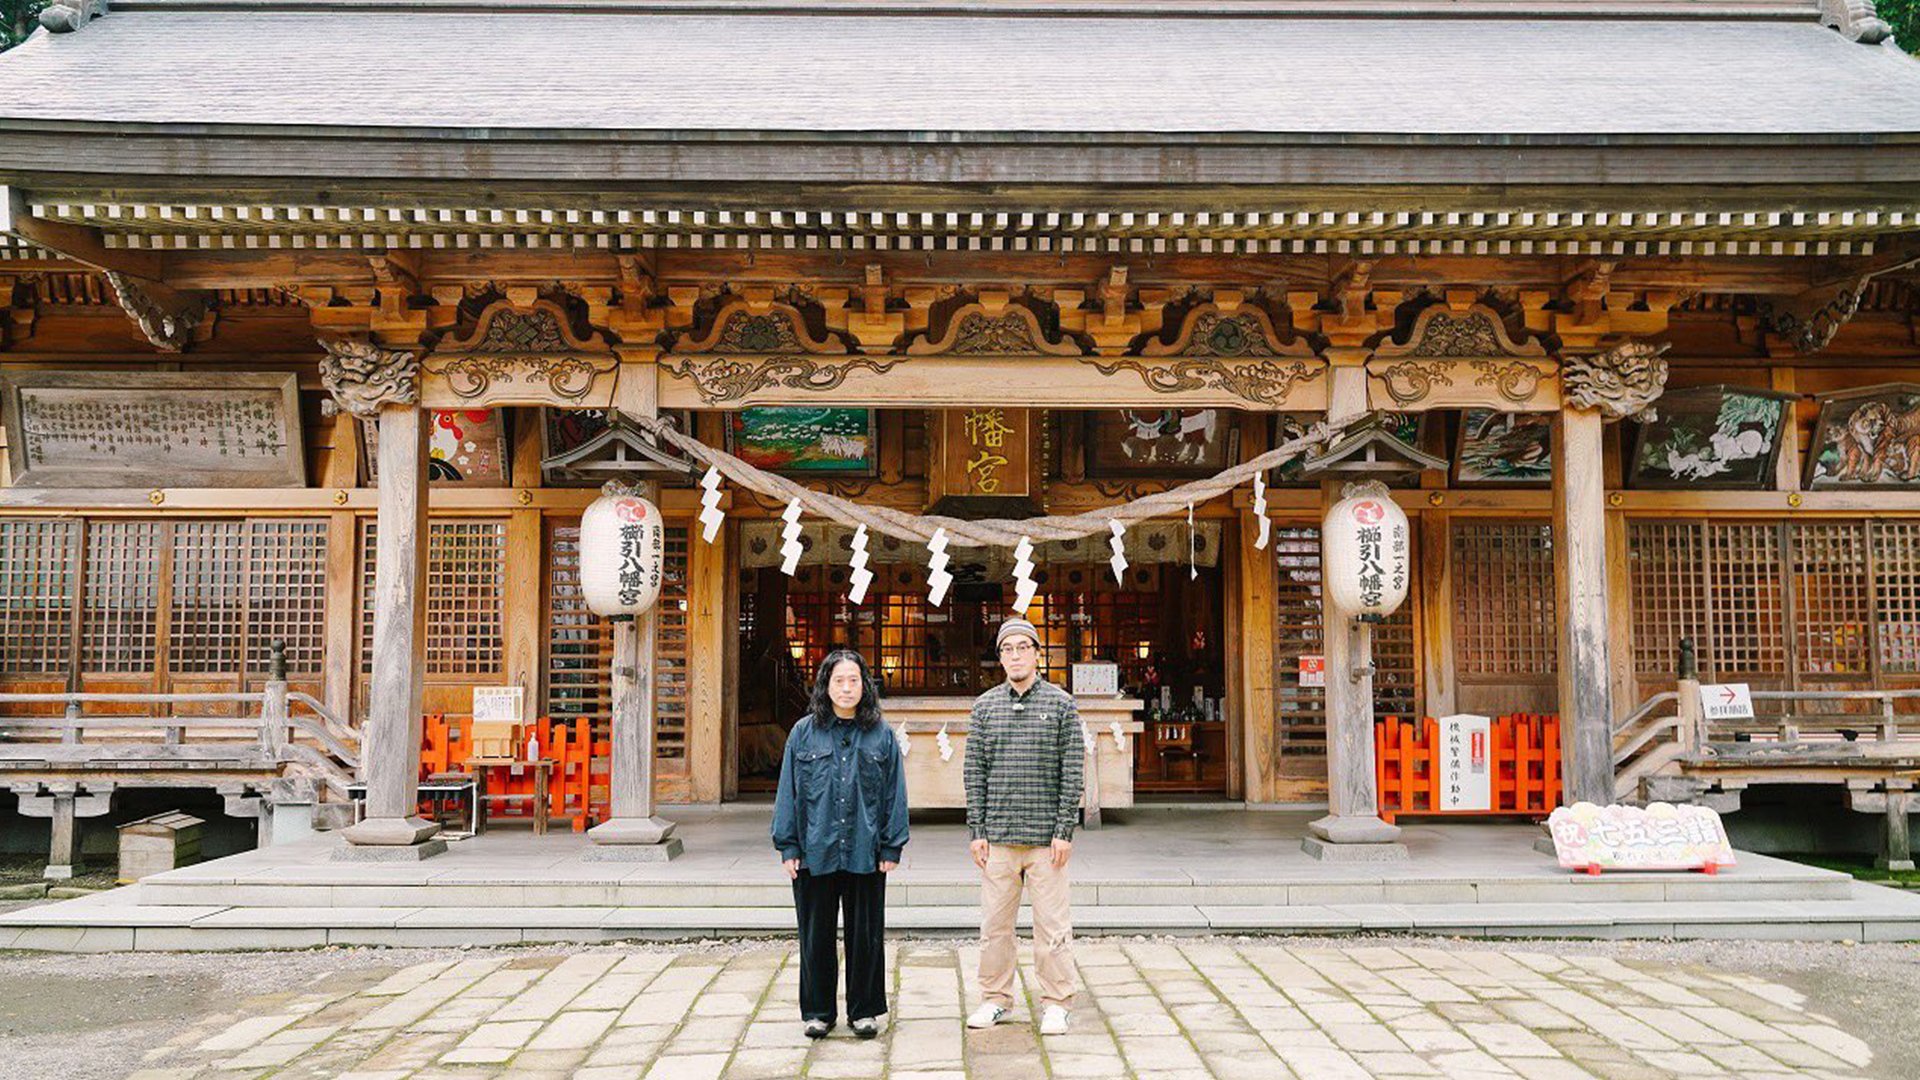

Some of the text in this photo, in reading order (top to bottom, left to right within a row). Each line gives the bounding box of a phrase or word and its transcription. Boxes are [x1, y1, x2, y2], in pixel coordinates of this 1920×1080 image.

[619, 524, 645, 605] 櫛引八幡宮
[1356, 527, 1386, 606] 櫛引八幡宮
[1449, 722, 1461, 806] 機械警備作動中
